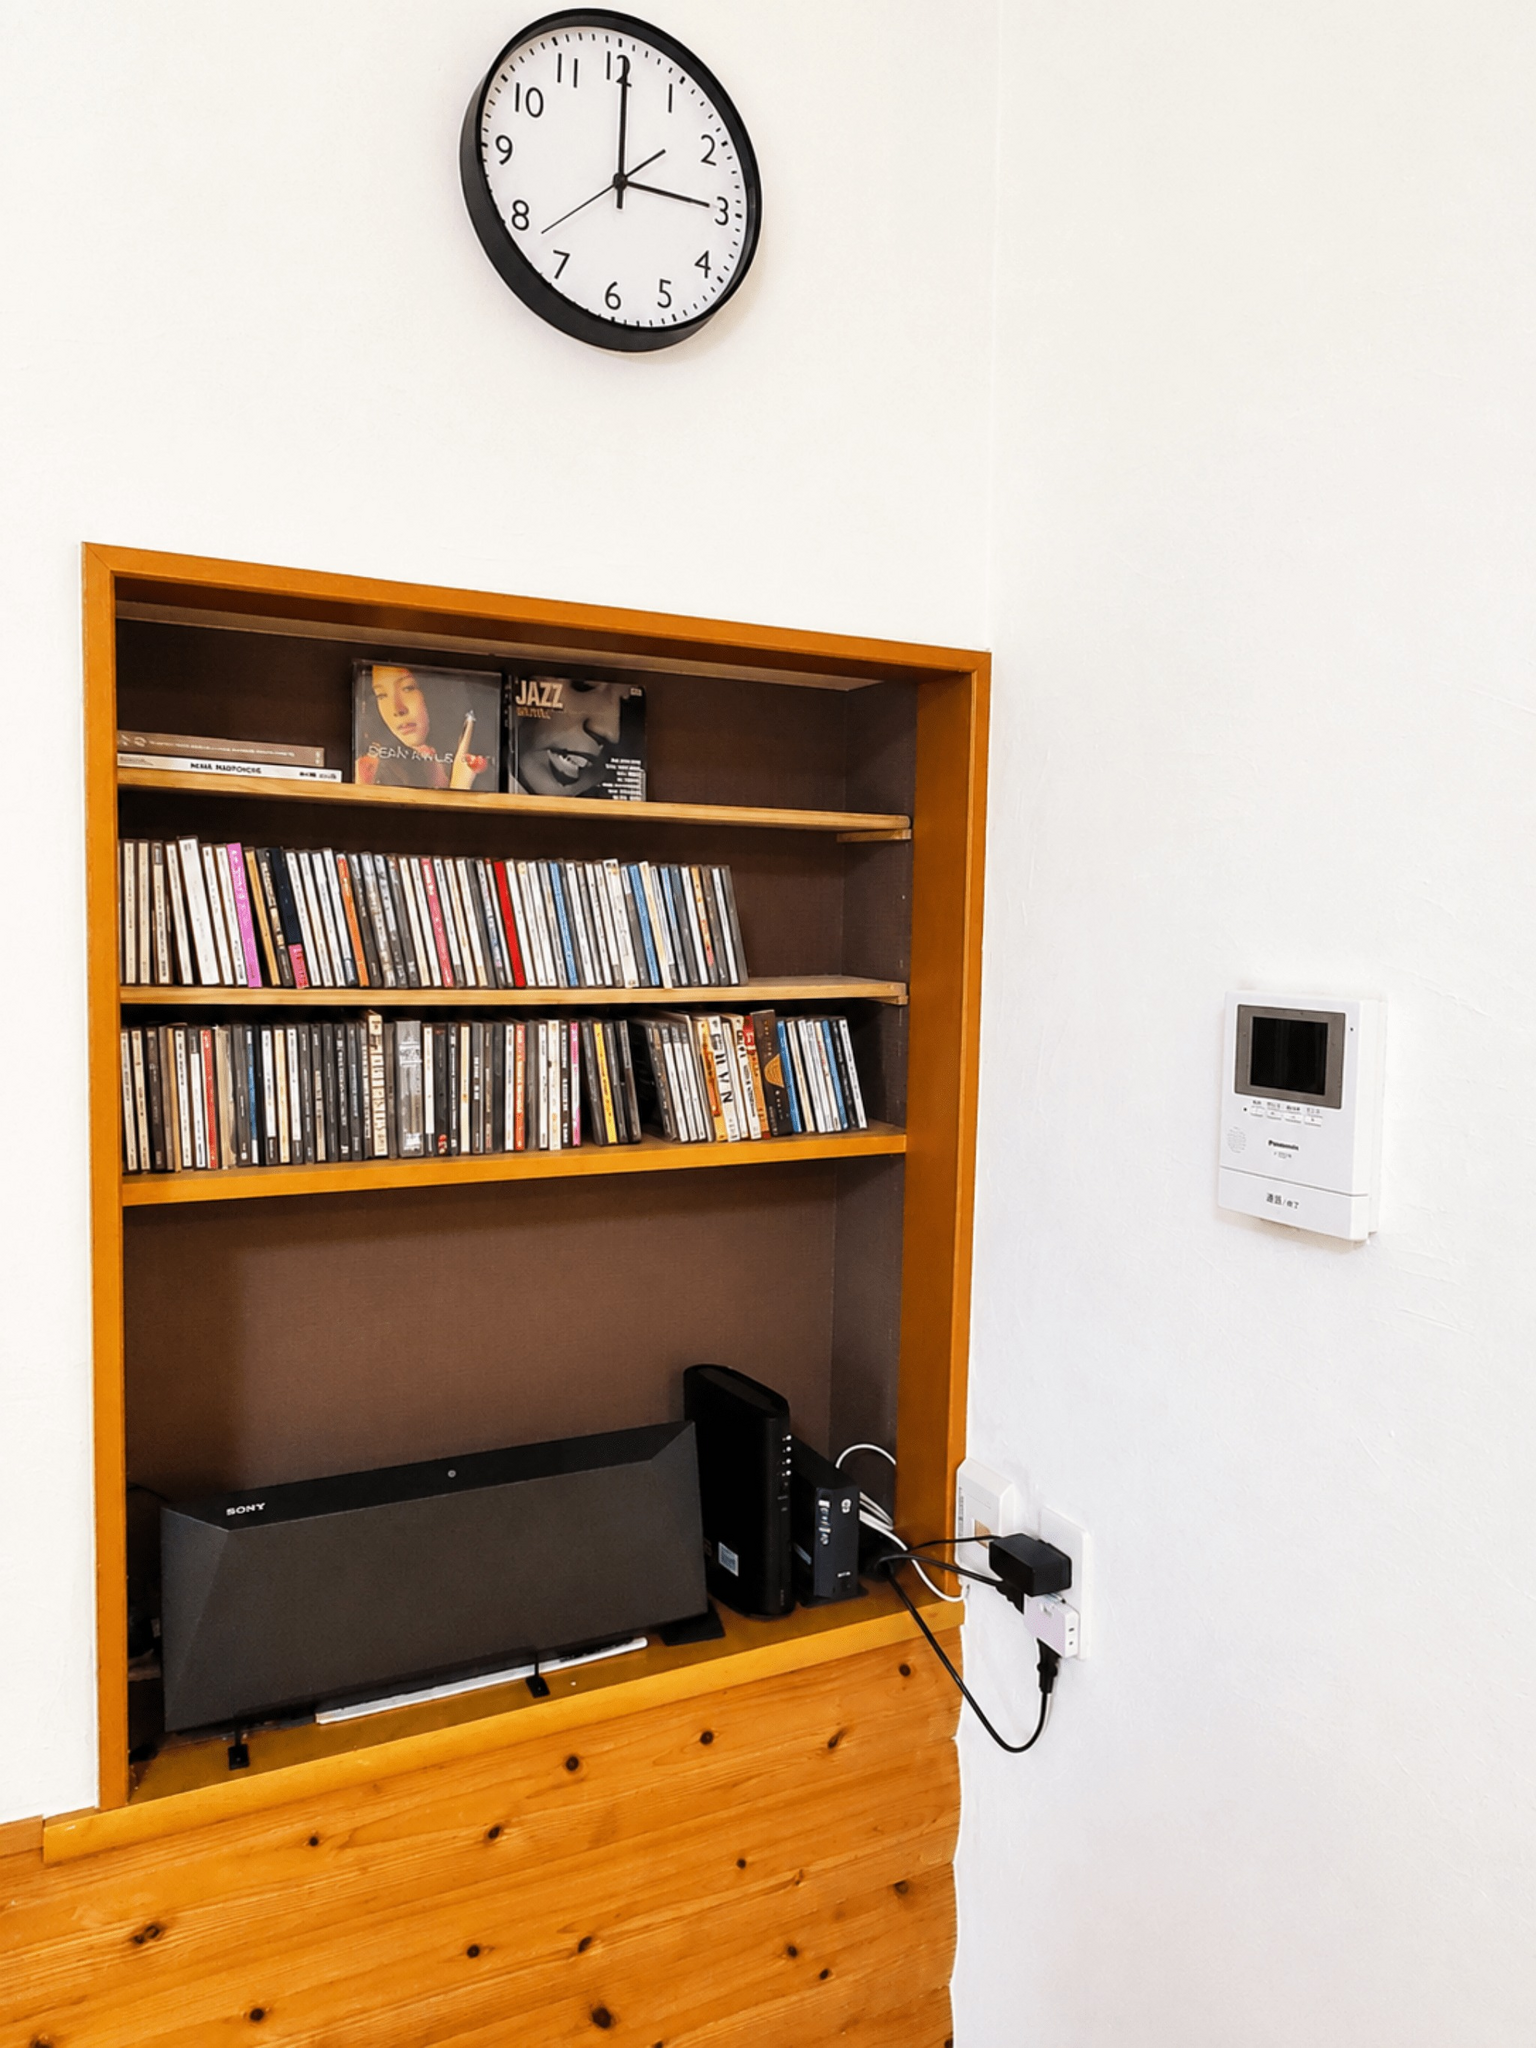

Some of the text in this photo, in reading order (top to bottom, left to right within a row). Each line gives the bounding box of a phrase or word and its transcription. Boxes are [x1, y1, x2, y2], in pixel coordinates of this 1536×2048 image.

[556, 52, 579, 89] 11
[605, 50, 633, 88] 12
[514, 81, 545, 119] 10
[666, 82, 675, 114] 1
[494, 133, 514, 166] 9
[699, 133, 718, 167] 2
[510, 198, 531, 233] 8
[713, 195, 730, 227] 3
[551, 248, 572, 281] 7
[693, 249, 713, 280] 4
[603, 280, 623, 311] 6
[656, 278, 673, 309] 5
[515, 680, 564, 709] JAZZ
[226, 1502, 266, 1516] SONY
